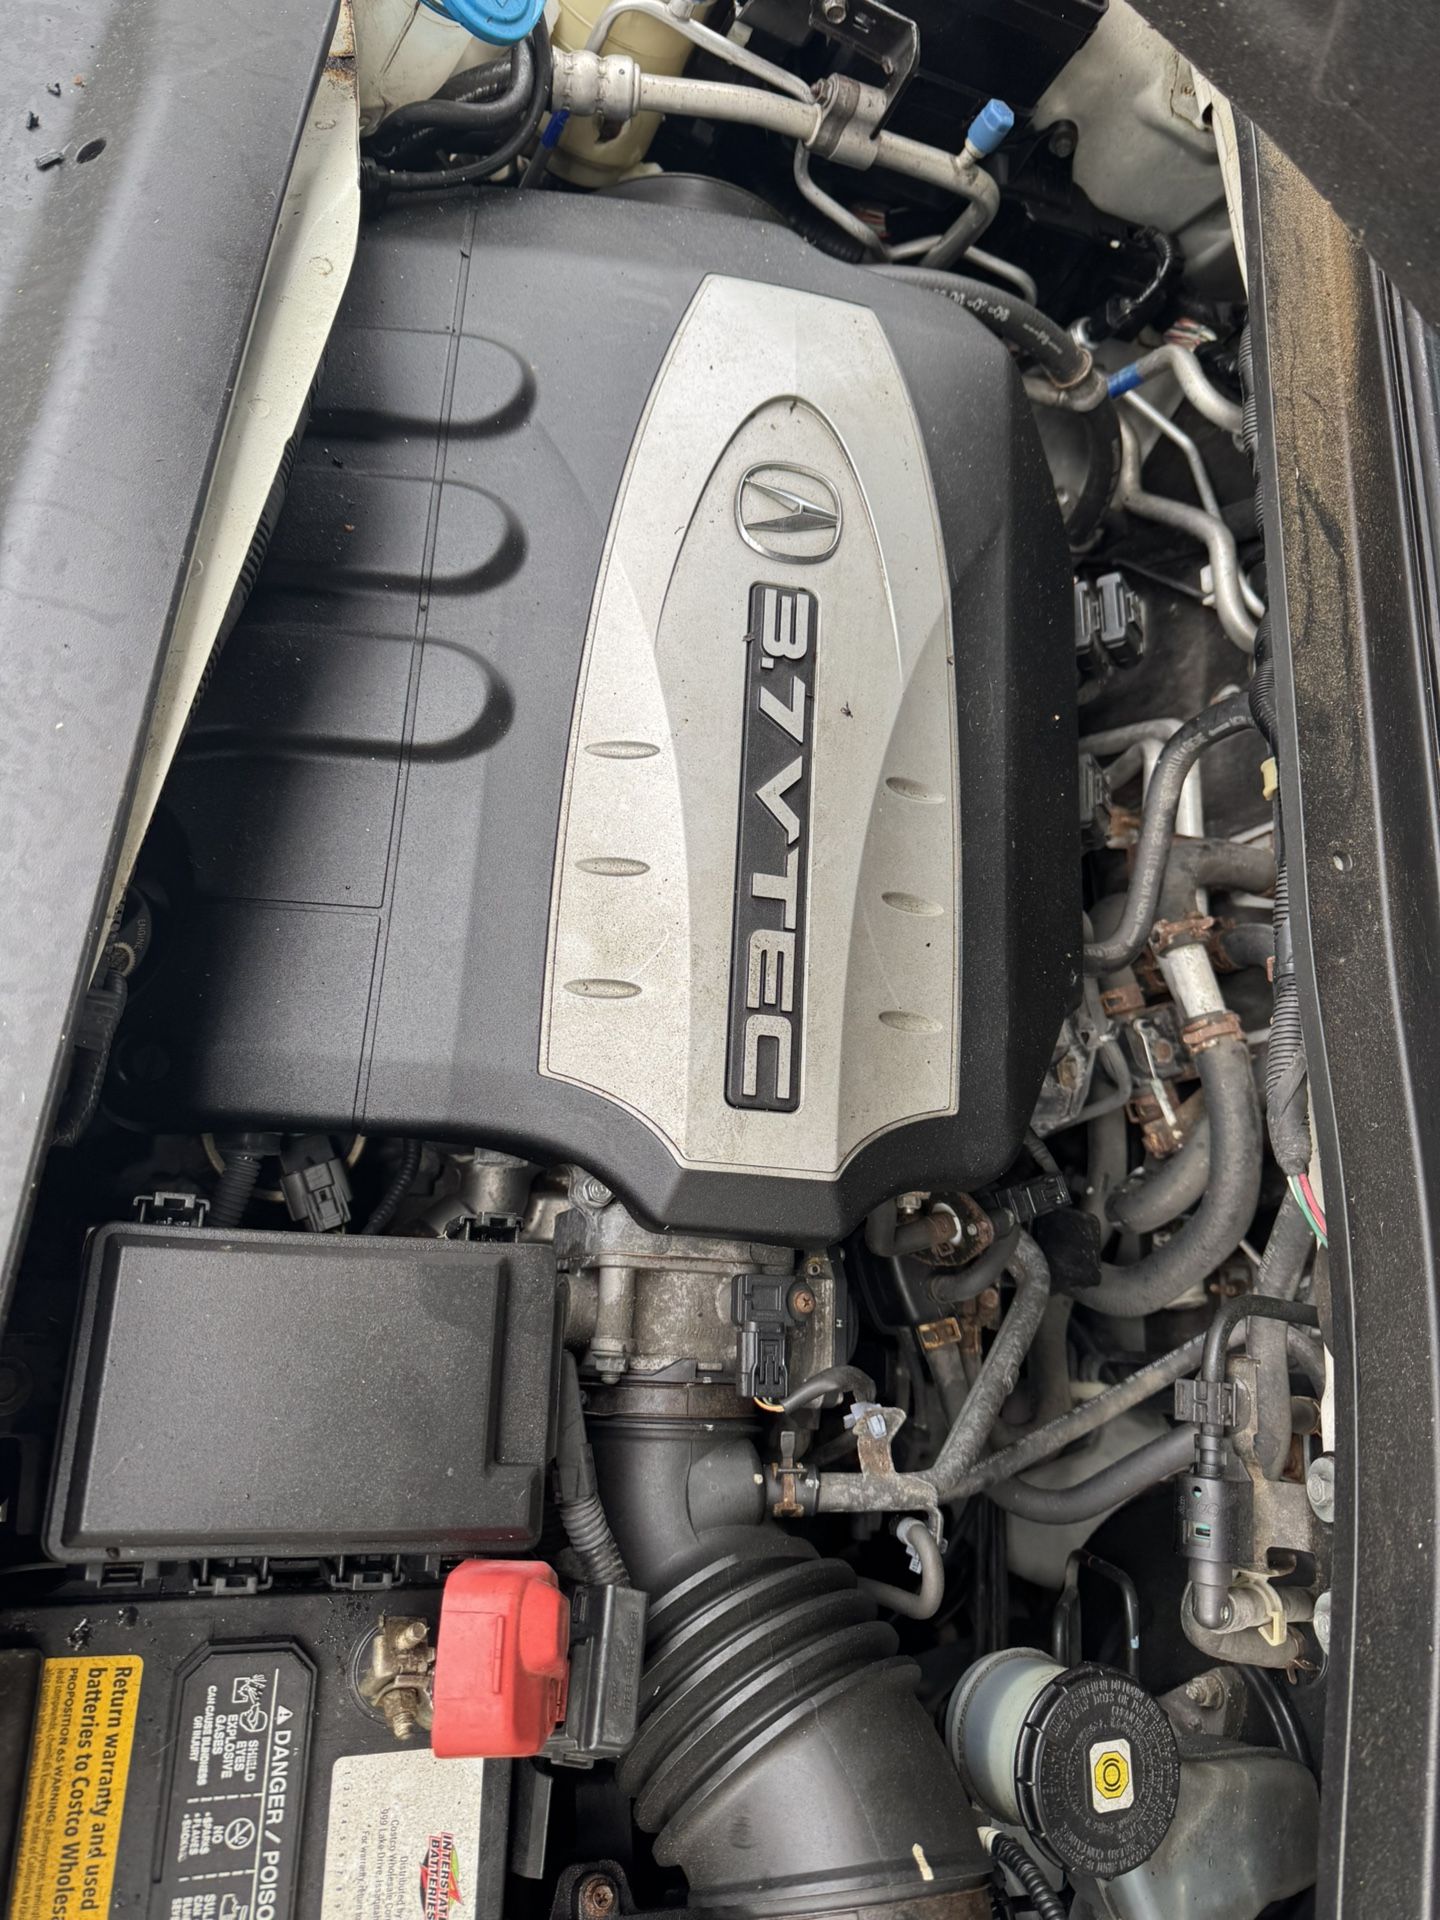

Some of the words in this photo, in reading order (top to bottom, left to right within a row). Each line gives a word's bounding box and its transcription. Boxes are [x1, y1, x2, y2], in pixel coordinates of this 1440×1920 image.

[757, 588, 811, 744] 3.7
[742, 755, 803, 1102] VTEC
[56, 1668, 67, 1684] lead
[108, 1666, 133, 1728] Return
[206, 1685, 218, 1704] CAN
[59, 1667, 78, 1745] PROPOSITION
[78, 1667, 108, 1748] batteries
[193, 1716, 203, 1729] OR
[202, 1705, 215, 1735] CAUSE
[56, 1748, 65, 1762] 65
[189, 1730, 201, 1761] INJURY
[211, 1714, 227, 1755] GASES
[220, 1714, 239, 1779] EXPLOSIVE
[234, 1741, 247, 1771] EYES
[74, 1754, 93, 1771] to
[90, 1734, 120, 1816] warranty
[196, 1736, 212, 1786] BLINDNESS
[244, 1740, 259, 1782] SHIELD
[265, 1730, 292, 1824] DANGER
[47, 1765, 64, 1826] WARNING:
[64, 1777, 90, 1836] Costco
[88, 1823, 107, 1857] and
[211, 1825, 224, 1844] NO
[377, 1829, 386, 1850] Lake
[389, 1819, 399, 1851] Costco
[80, 1865, 100, 1910] used
[386, 1853, 397, 1900] Wholesale
[396, 1856, 408, 1905] Distributed
[426, 1839, 440, 1920] BATTERIES
[395, 1908, 404, 1918] by
